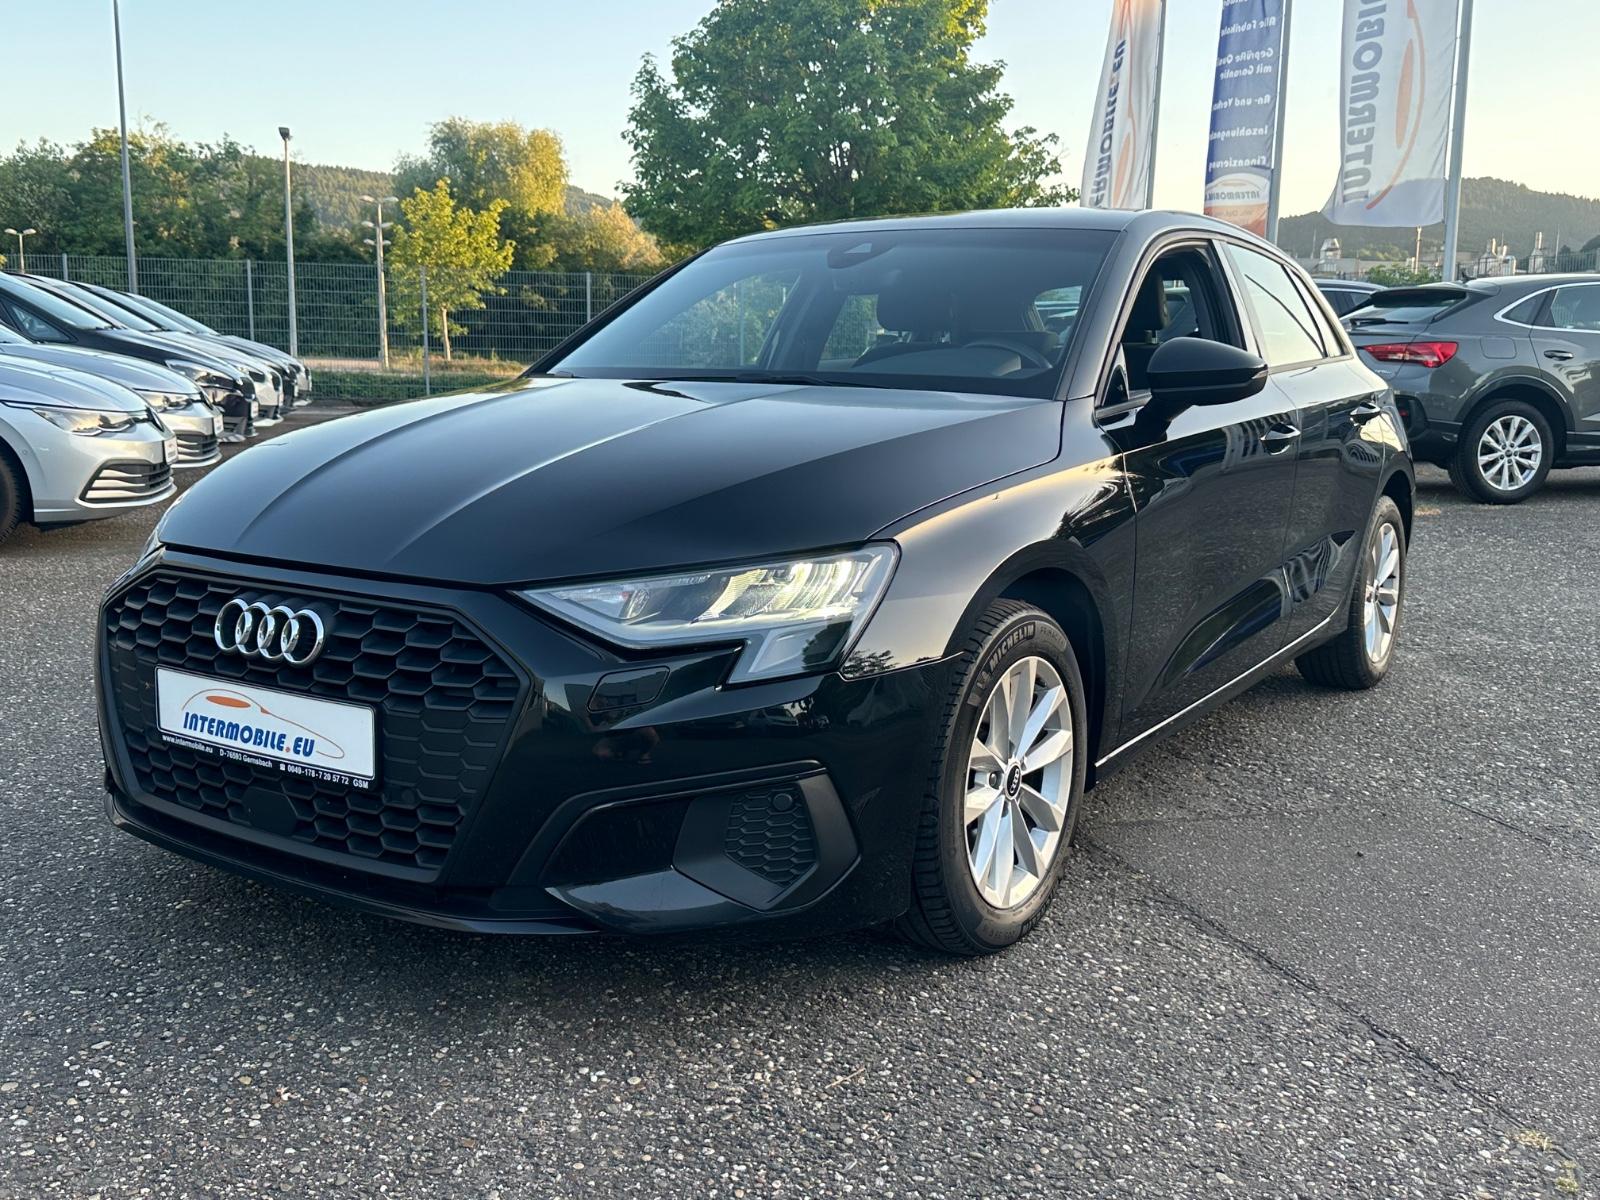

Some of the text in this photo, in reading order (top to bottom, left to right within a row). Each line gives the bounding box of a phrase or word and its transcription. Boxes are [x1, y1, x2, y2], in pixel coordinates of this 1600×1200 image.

[989, 624, 1034, 671] MICHELIN
[183, 711, 315, 757] INTERMOBILE.EU
[161, 734, 214, 754] www.intermobile.eu
[242, 754, 273, 768] Gernsbach
[352, 779, 369, 789] GSM
